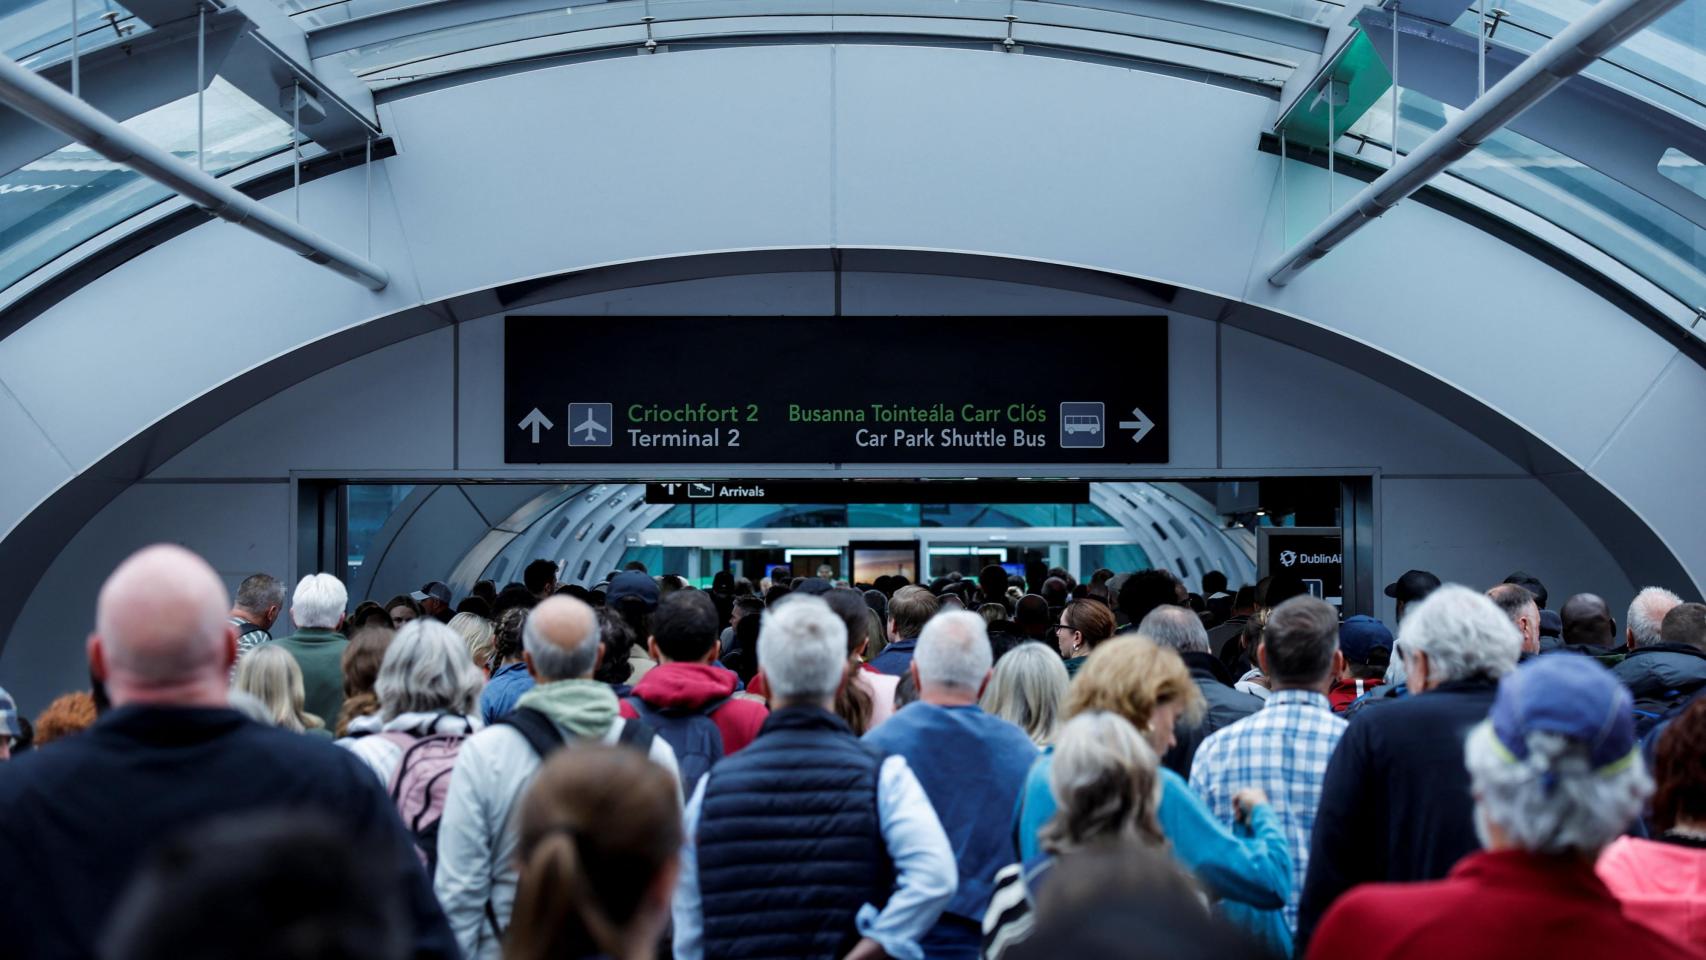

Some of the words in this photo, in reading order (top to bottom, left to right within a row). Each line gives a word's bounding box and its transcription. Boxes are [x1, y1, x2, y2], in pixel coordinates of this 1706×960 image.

[628, 403, 738, 422] Criochfort
[746, 404, 758, 422] 2
[789, 404, 865, 422] Busanna
[871, 403, 955, 422] Tointeála
[961, 404, 1001, 422] Carr
[1007, 403, 1046, 422] Clós
[627, 428, 719, 447] Terminal
[727, 429, 740, 447] 2
[855, 429, 888, 447] Car
[894, 428, 935, 447] Park
[940, 428, 1007, 447] Shuttle
[1013, 429, 1046, 447] Bus
[719, 485, 765, 497] Arrivals
